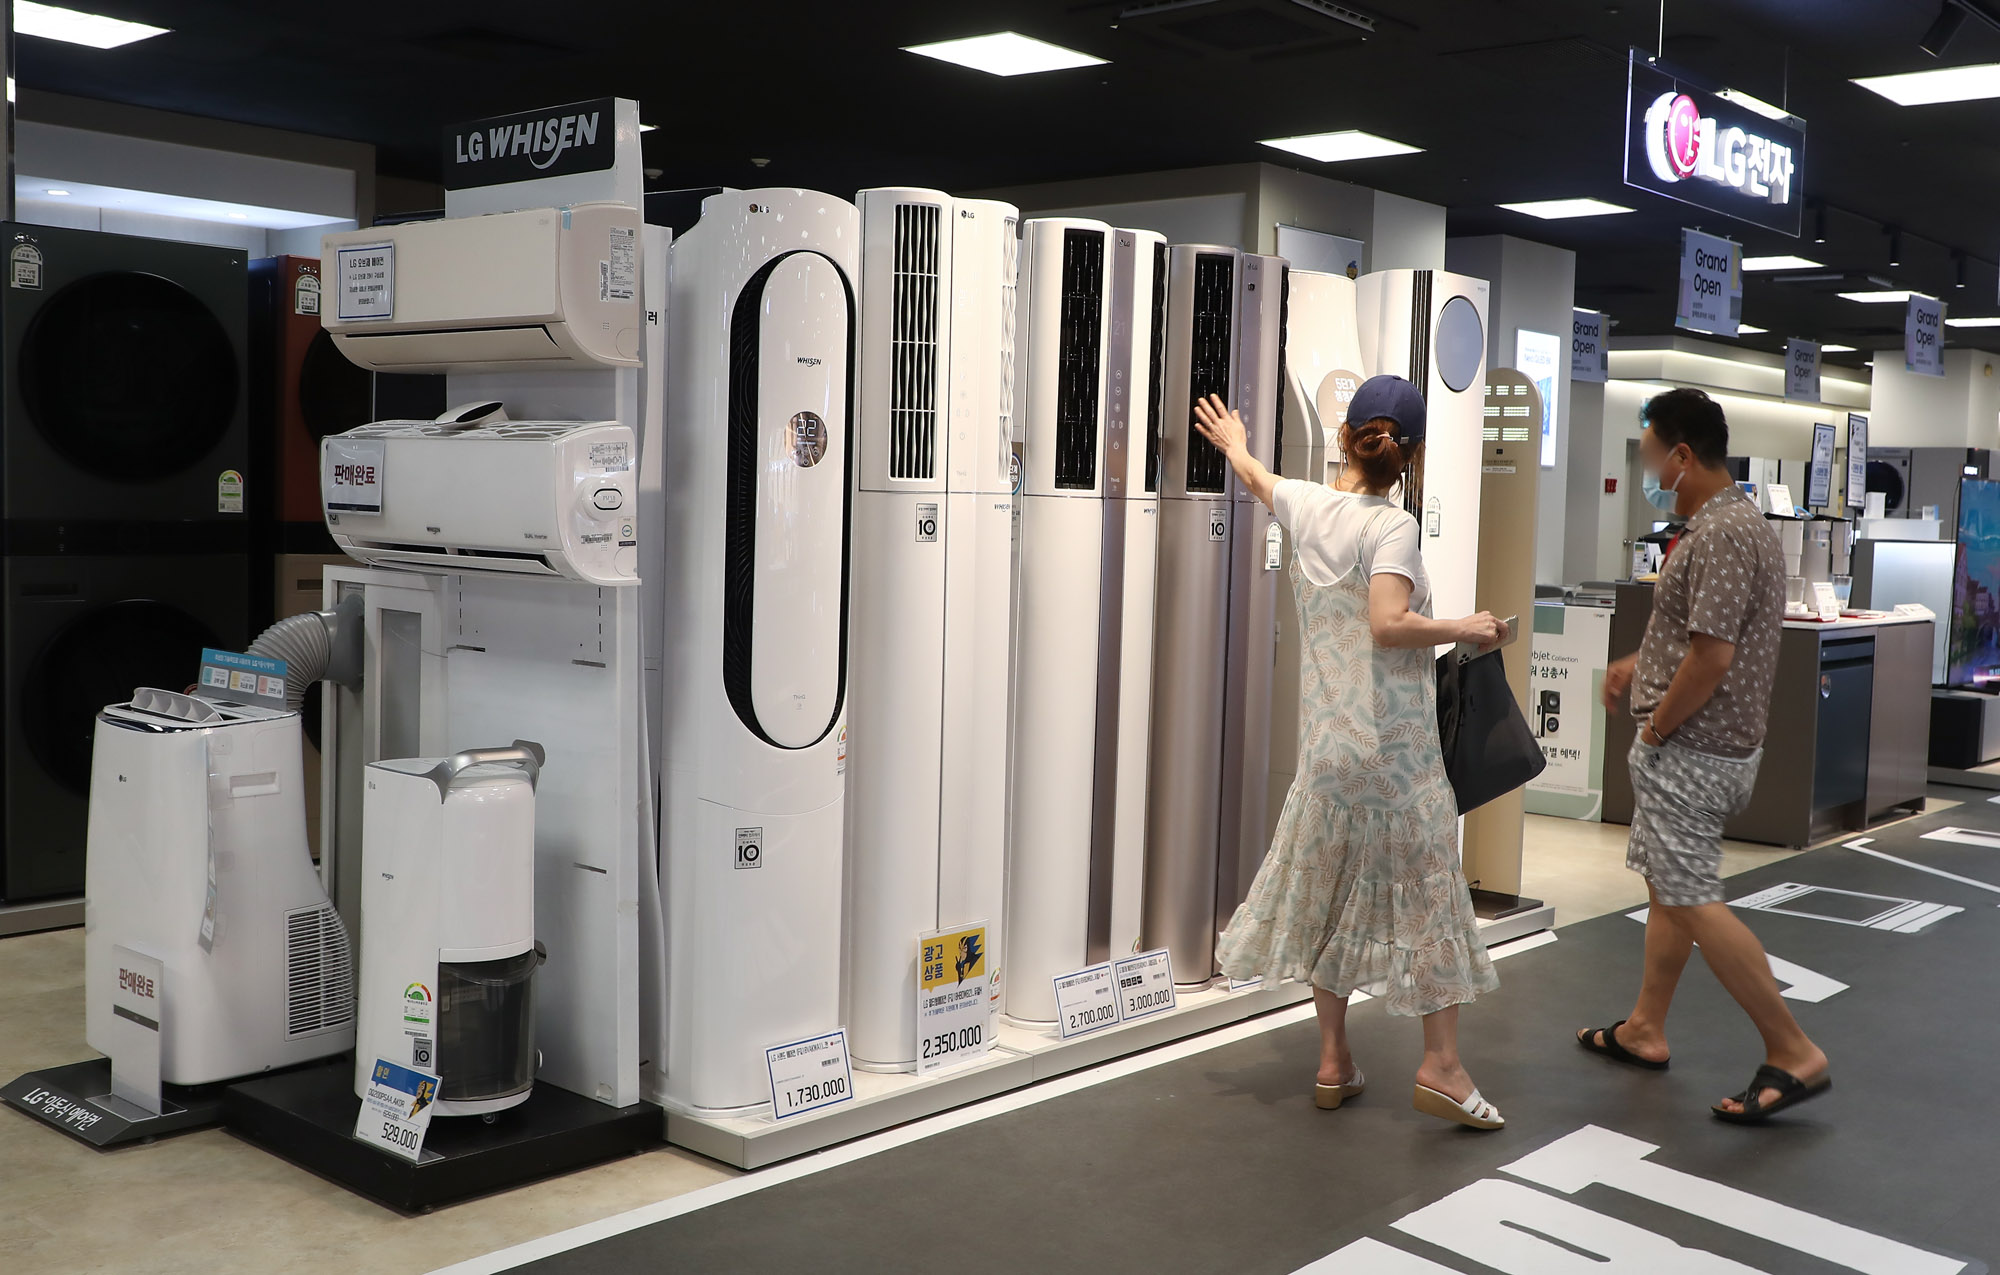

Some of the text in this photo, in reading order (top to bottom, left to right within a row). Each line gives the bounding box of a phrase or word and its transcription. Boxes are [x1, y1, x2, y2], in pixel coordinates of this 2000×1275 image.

[456, 112, 600, 169] LG WHISEN
[1698, 117, 1796, 204] LG전자
[349, 259, 357, 268] LG
[1695, 248, 1728, 273] Grand
[1693, 271, 1721, 299] Open
[1916, 308, 1938, 327] Grand
[1573, 321, 1599, 337] Grand
[1916, 328, 1935, 349] Open
[1572, 339, 1595, 357] Open
[1794, 348, 1815, 364] Grand
[797, 356, 822, 367] WHISEN
[1794, 365, 1811, 381] Open
[334, 464, 377, 486] 판매완료
[919, 519, 936, 536] 10
[1211, 522, 1225, 536] 10
[1551, 655, 1579, 663] Collection
[1540, 665, 1568, 680] 삼총사
[1541, 745, 1580, 760] 특별 혜택!
[738, 845, 760, 862] 10
[924, 944, 943, 963] 광고
[924, 963, 943, 982] 상품
[119, 967, 155, 999] 판매완료
[1129, 989, 1170, 1012] 3,000,000
[1070, 1004, 1114, 1029] 2,700,000
[923, 1025, 982, 1059] 2,350,000
[786, 1077, 845, 1108] 1,730,000
[22, 1087, 103, 1132] LG 이동식 에어컨
[381, 1122, 418, 1149] 529,000
